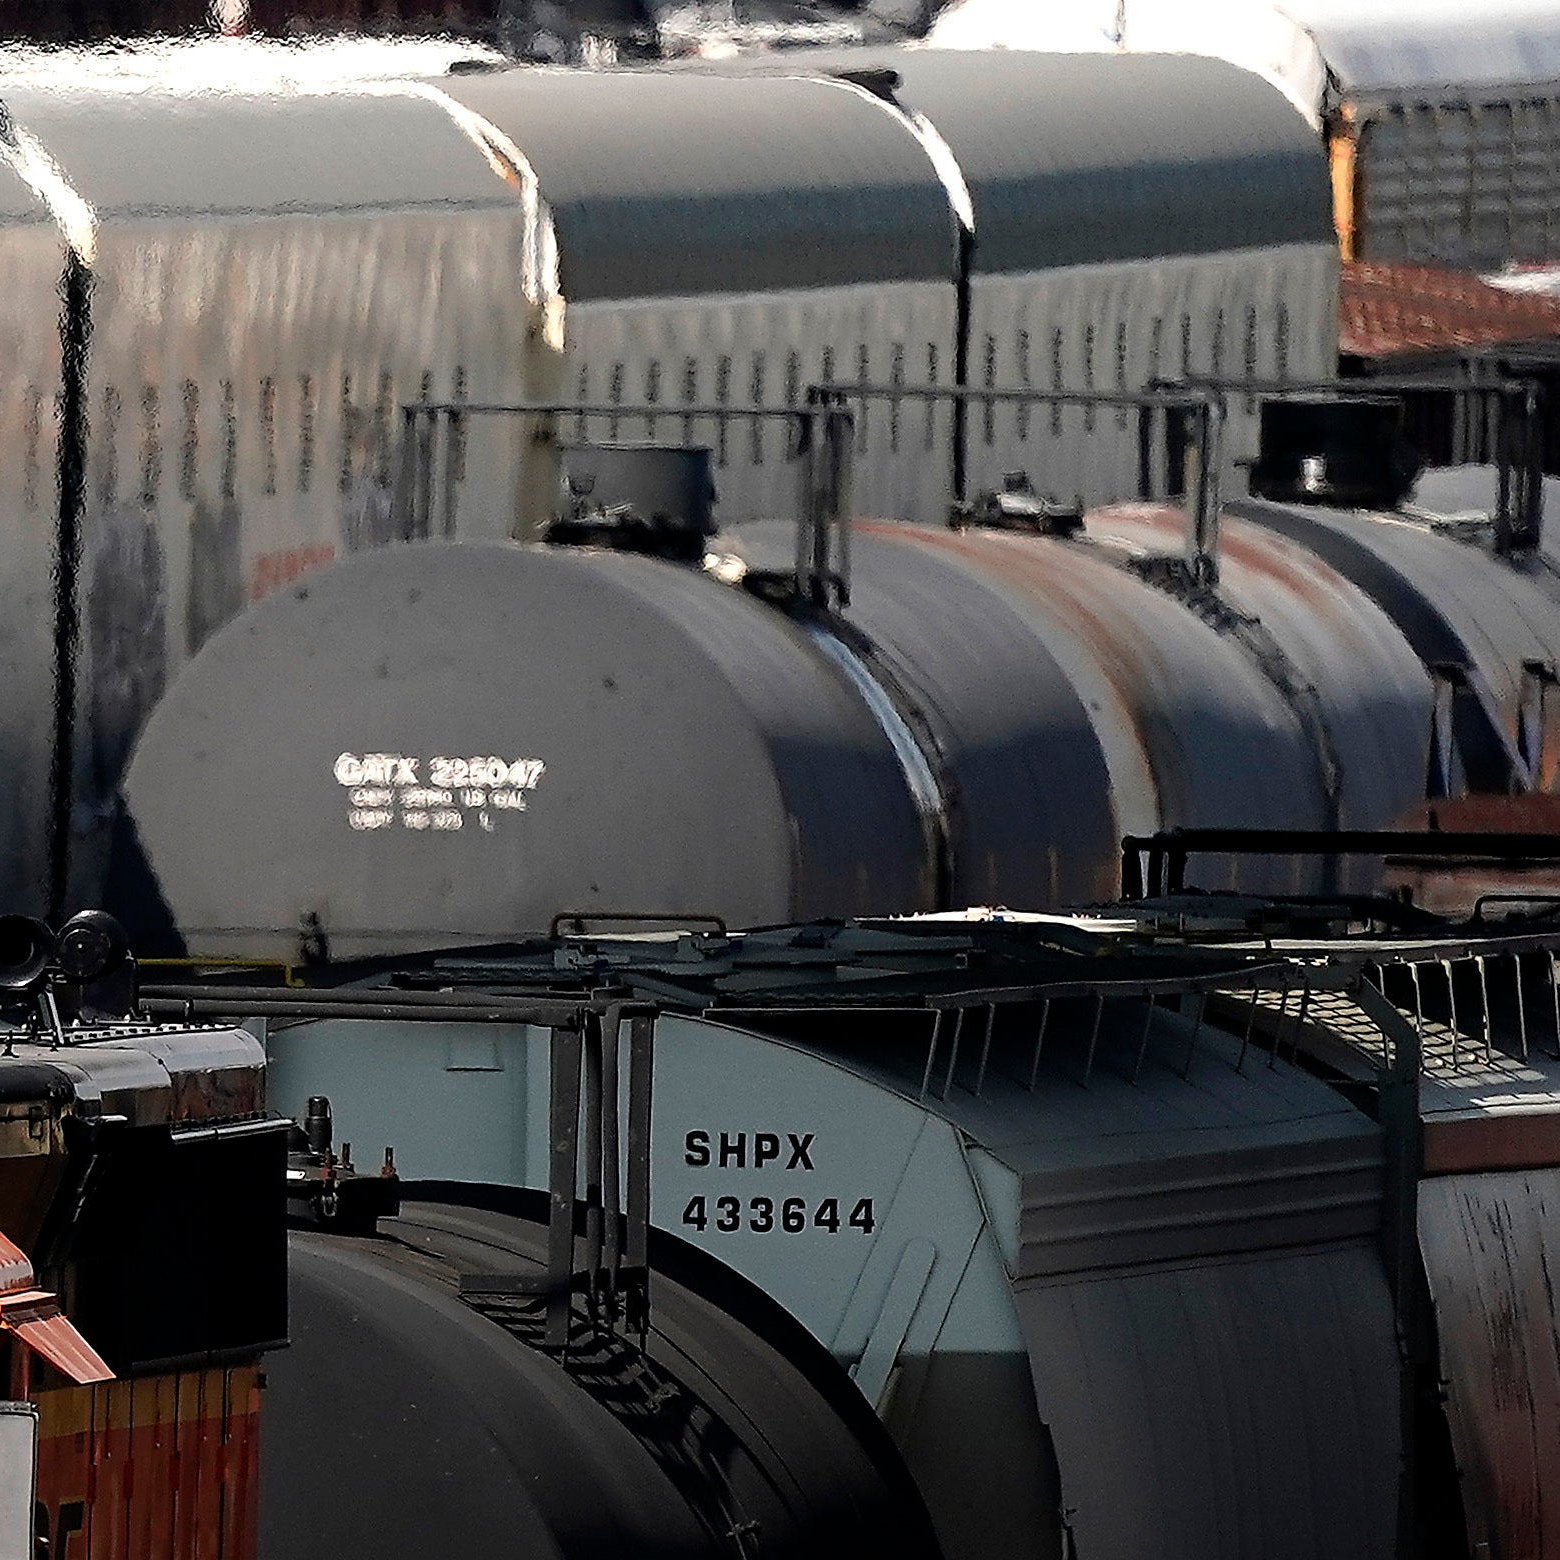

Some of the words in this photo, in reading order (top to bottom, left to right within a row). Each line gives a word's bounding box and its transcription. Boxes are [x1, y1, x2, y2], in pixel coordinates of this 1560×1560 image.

[334, 752, 421, 787] GATX
[684, 1129, 816, 1171] SHPX
[682, 1195, 876, 1235] 433644
